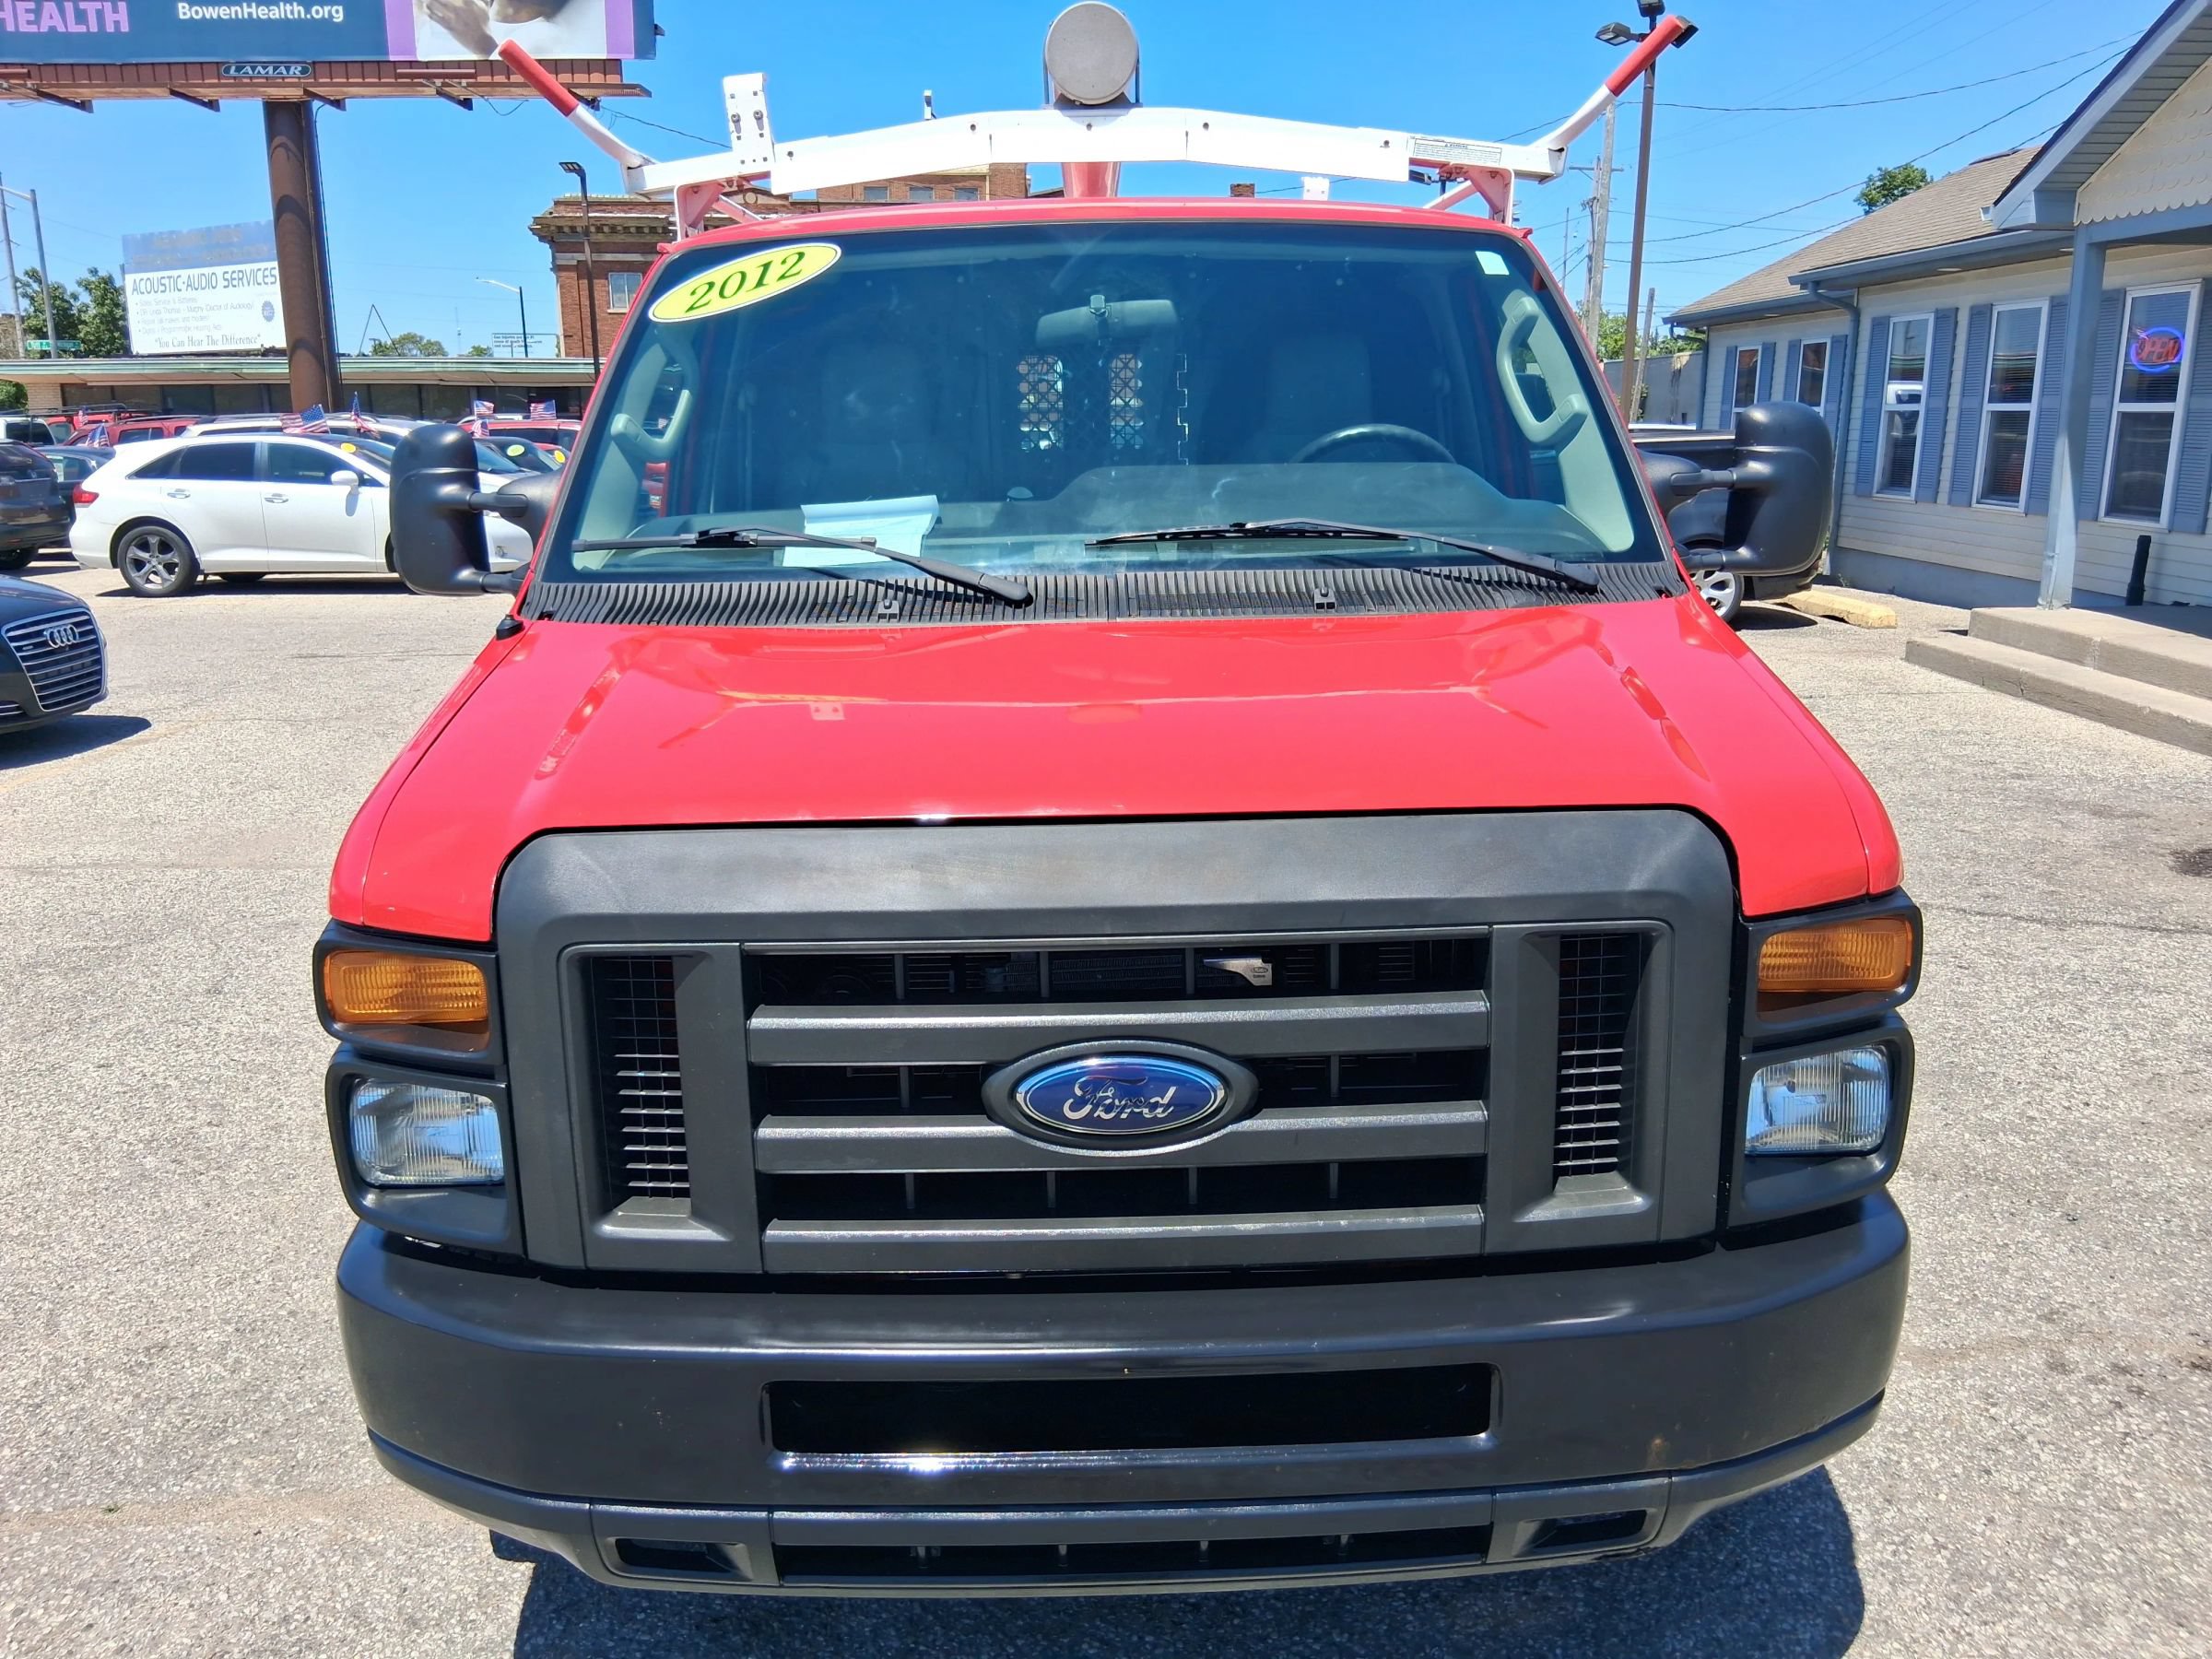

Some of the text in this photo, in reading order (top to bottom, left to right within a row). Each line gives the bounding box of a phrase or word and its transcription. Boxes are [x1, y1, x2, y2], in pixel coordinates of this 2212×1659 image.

[178, 2, 344, 22] BowenHealth.org
[229, 65, 302, 76] LAMAR
[222, 267, 277, 288] SERVICES
[685, 251, 806, 313] 2012
[172, 337, 184, 347] Can
[187, 335, 204, 347] Hear
[206, 335, 219, 346] The
[2136, 337, 2179, 362] OPEN
[1063, 1076, 1177, 1120] Ford
